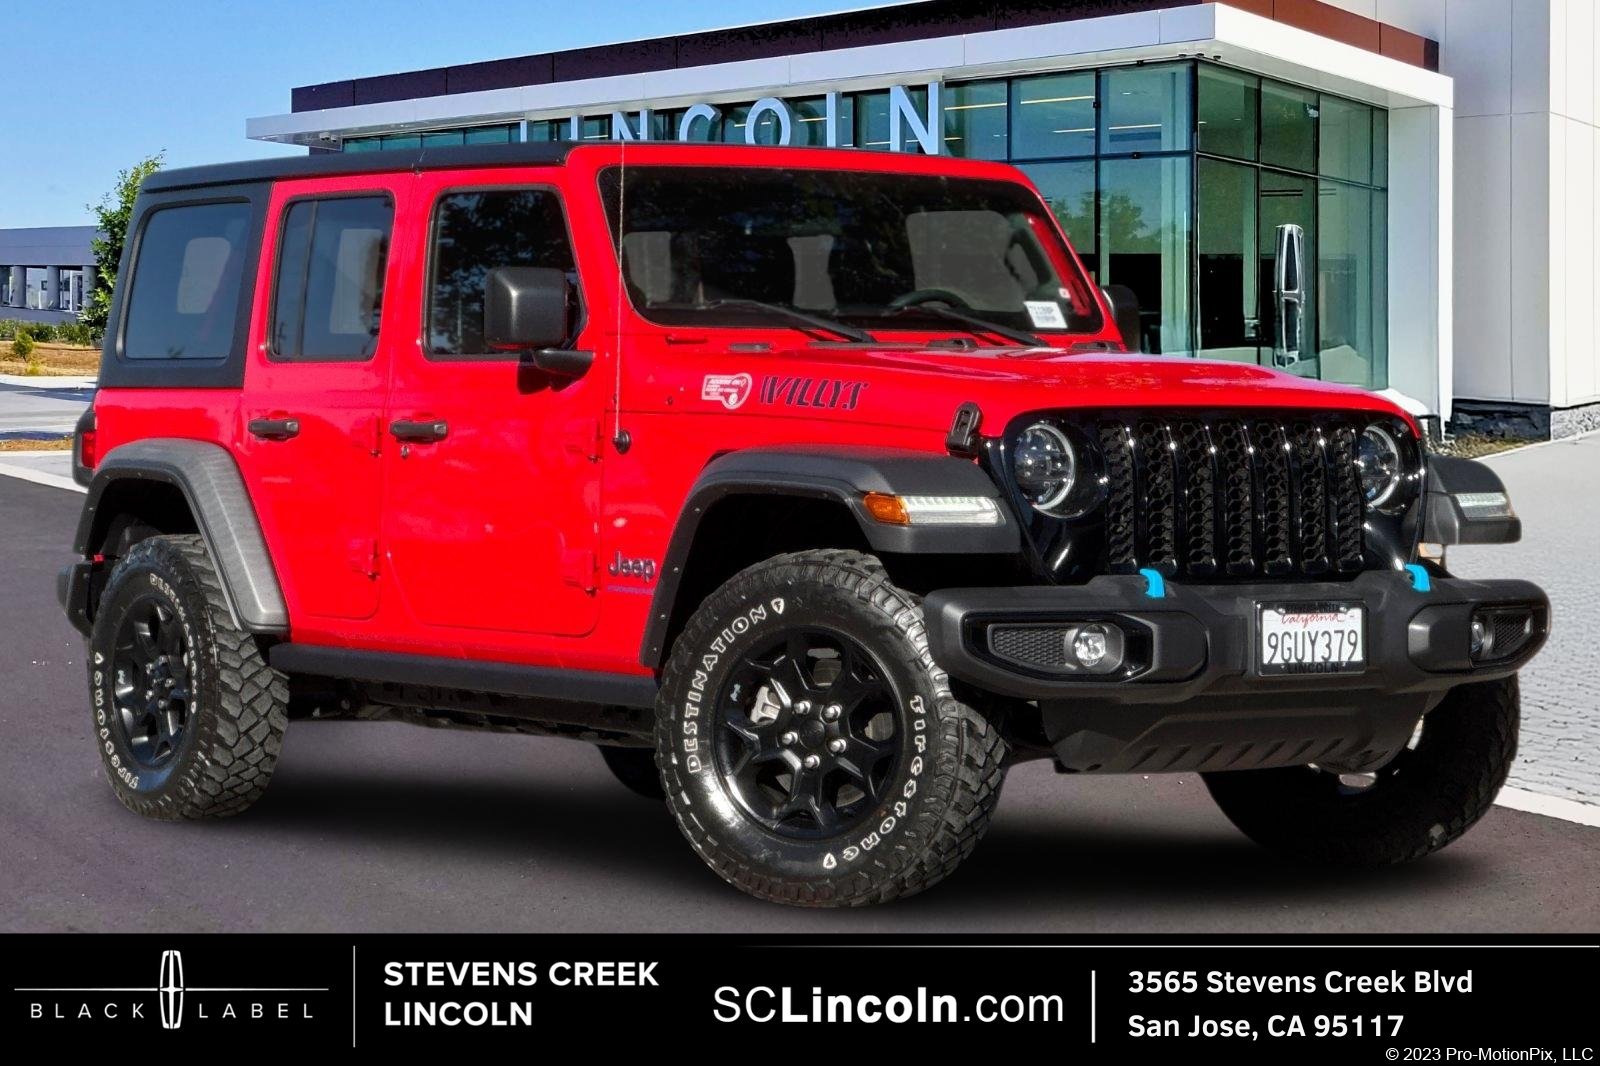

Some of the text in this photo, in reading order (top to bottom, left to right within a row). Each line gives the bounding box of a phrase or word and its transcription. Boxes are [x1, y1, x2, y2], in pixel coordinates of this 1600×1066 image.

[760, 376, 869, 410] WILLYS
[608, 550, 655, 583] Jeep
[1267, 629, 1358, 664] 9GUY379
[684, 603, 768, 774] DESTINATION
